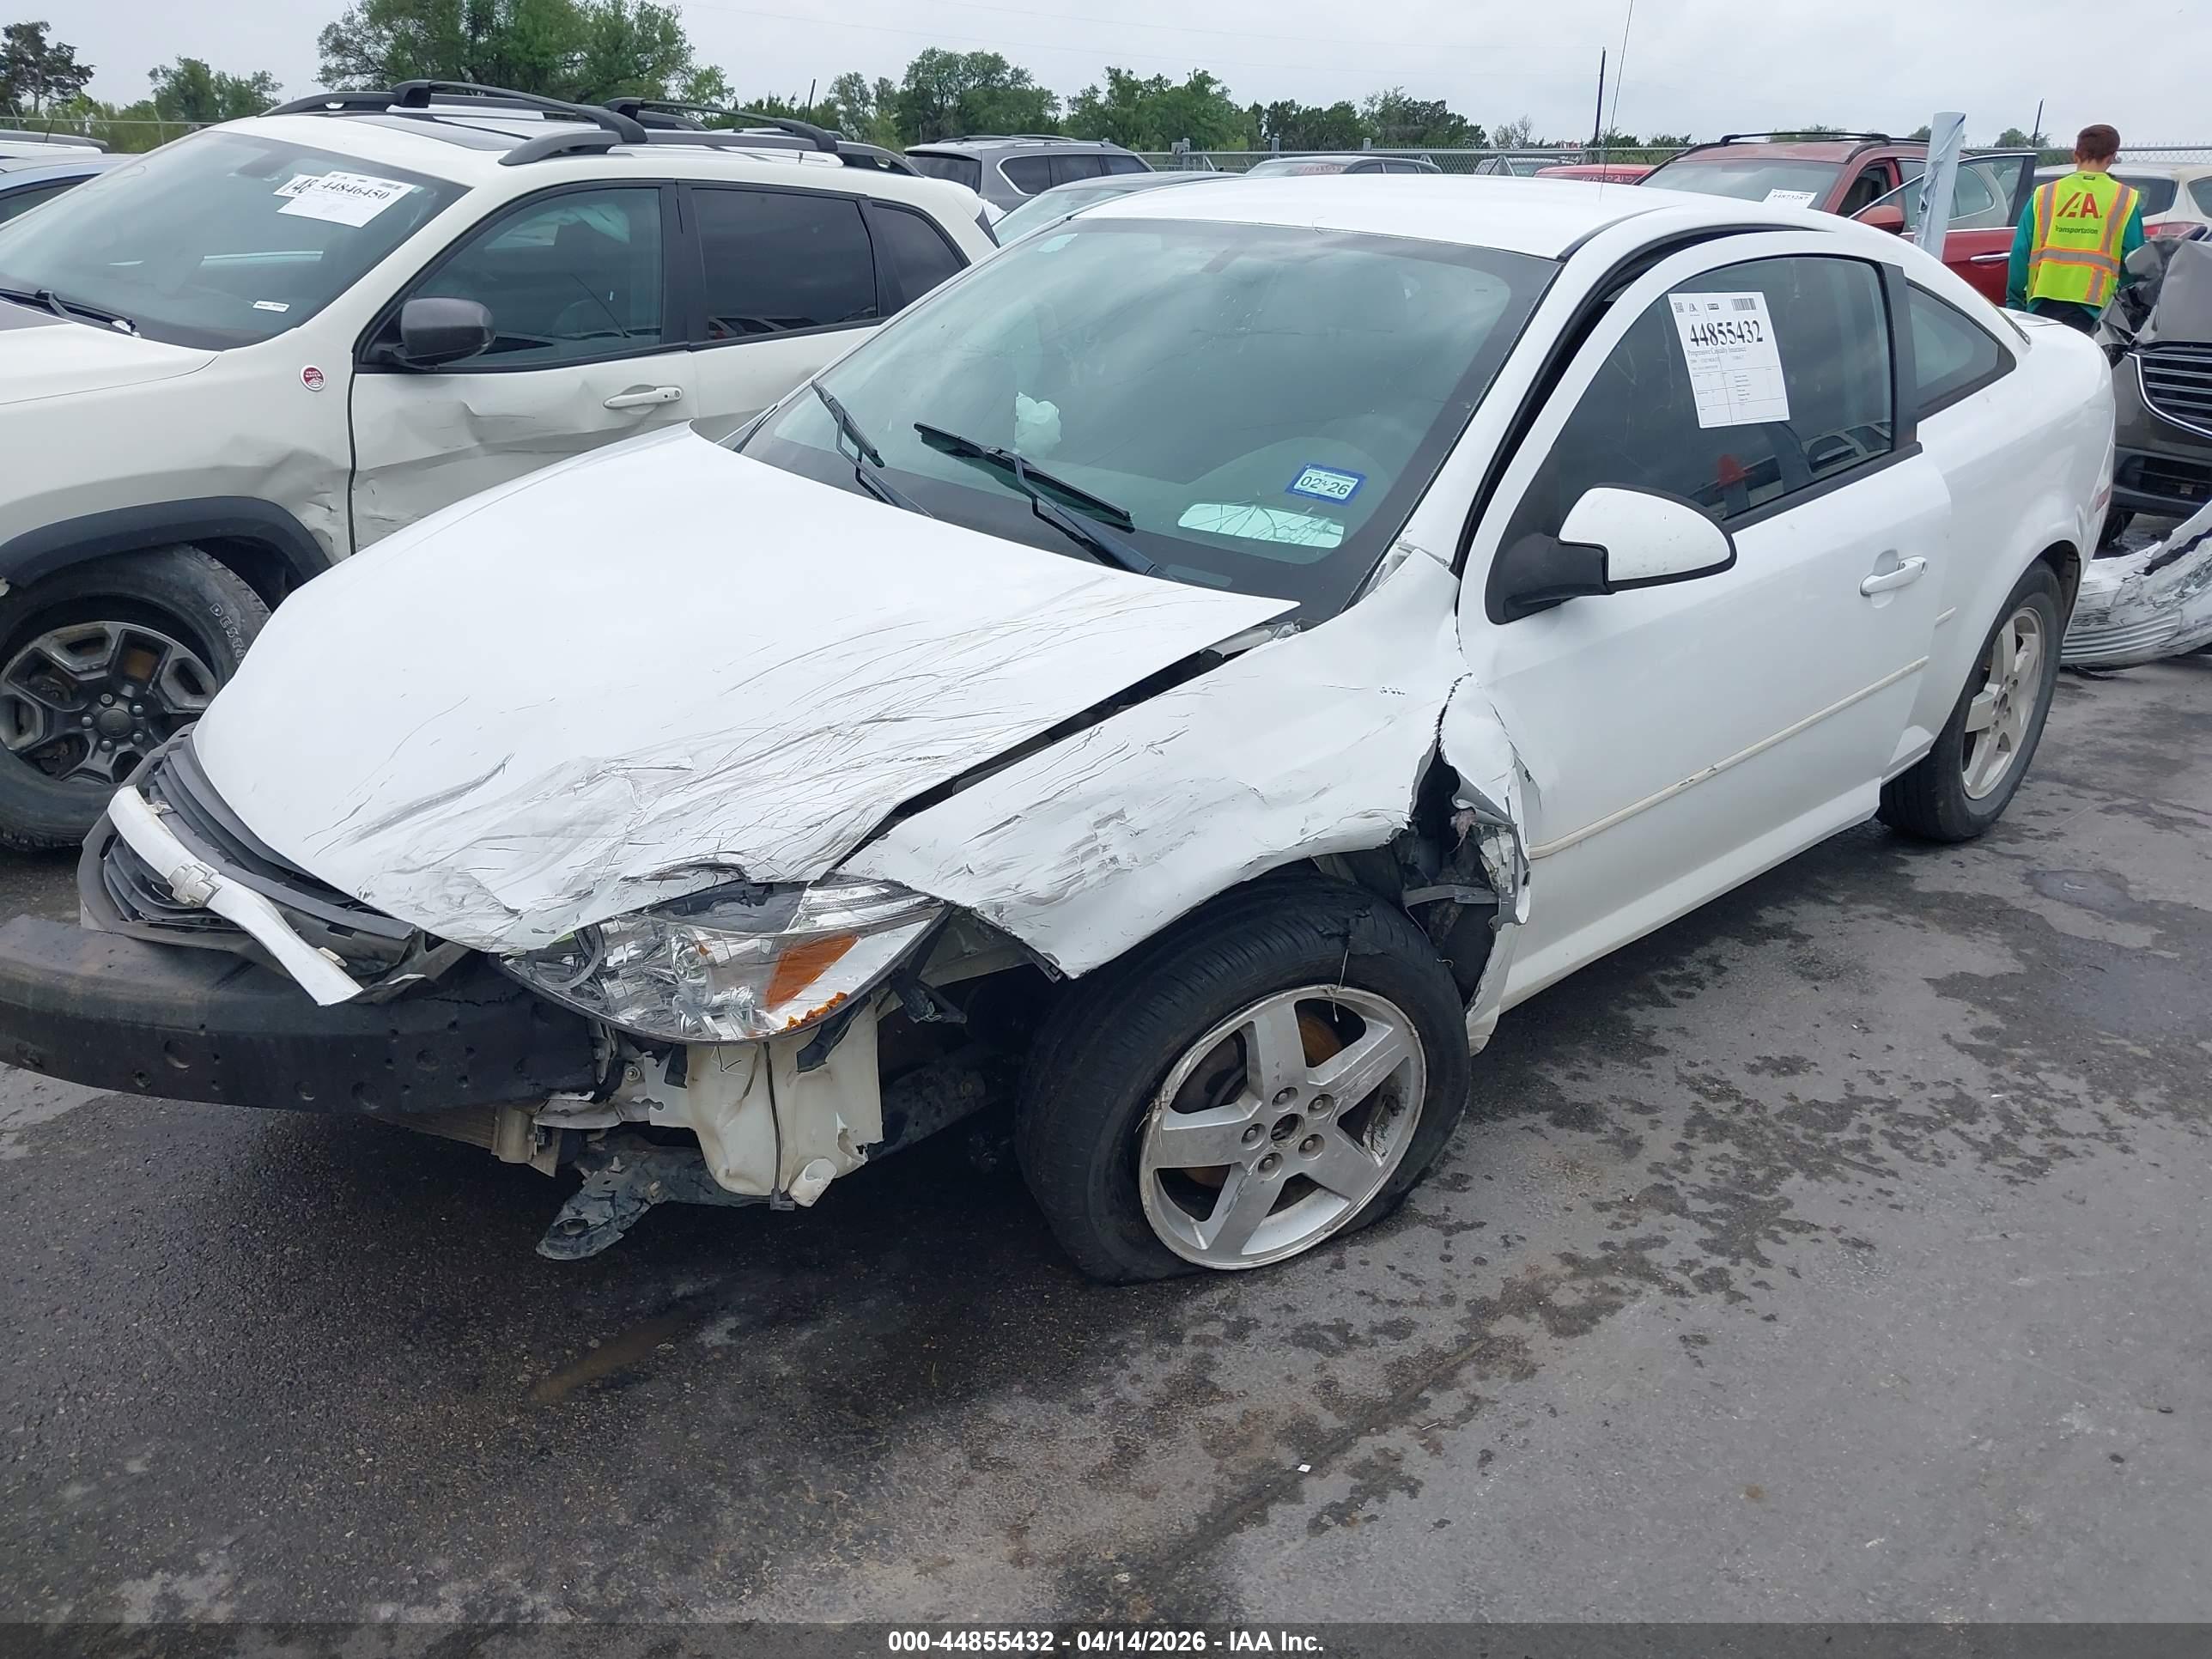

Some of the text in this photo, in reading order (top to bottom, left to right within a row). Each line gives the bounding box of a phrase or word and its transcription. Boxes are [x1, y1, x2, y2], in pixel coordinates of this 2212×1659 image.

[2055, 225, 2099, 234] Transportation
[1690, 319, 1763, 347] 44855432
[1300, 476, 1322, 489] 02
[1326, 482, 1351, 495] 26
